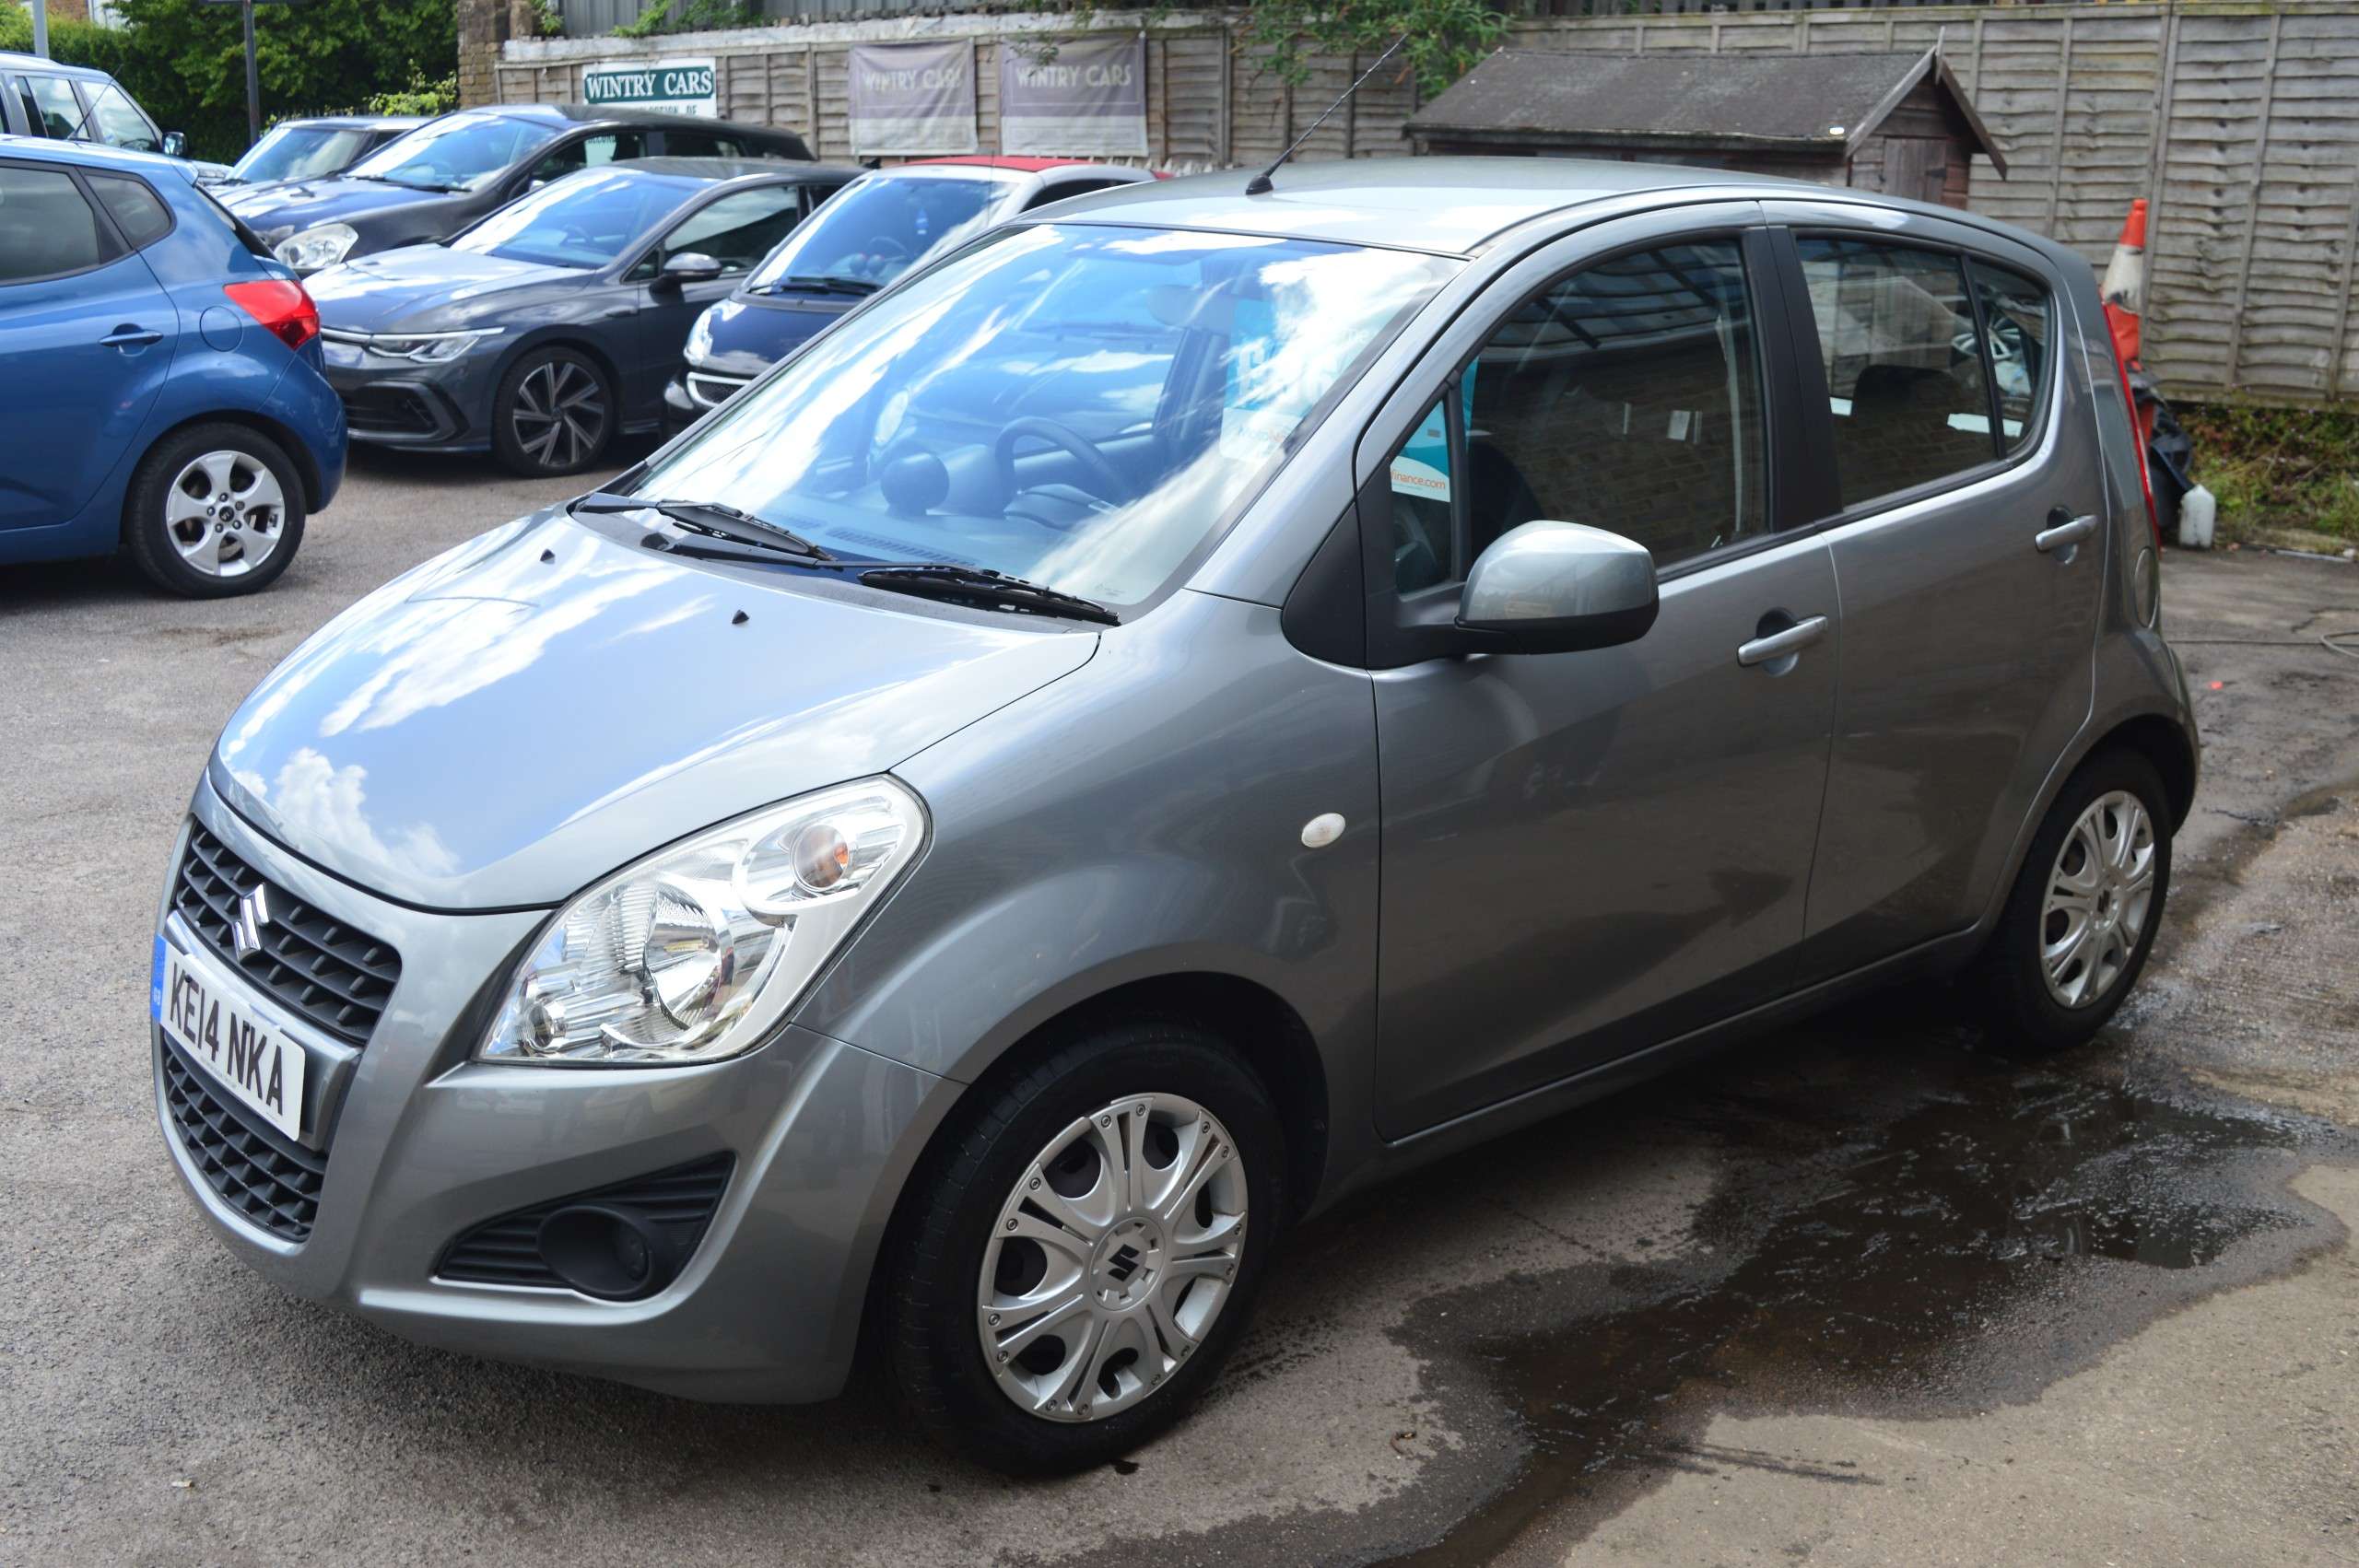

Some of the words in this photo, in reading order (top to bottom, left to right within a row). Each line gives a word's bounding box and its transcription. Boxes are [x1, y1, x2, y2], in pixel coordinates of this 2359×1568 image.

[587, 75, 656, 99] WINTRY
[664, 71, 712, 95] CARS
[862, 70, 918, 91] WINTRY
[1016, 64, 1080, 88] WINTRY
[1086, 64, 1132, 87] CARS
[170, 962, 220, 1062] KE14
[227, 1012, 284, 1117] NKA
